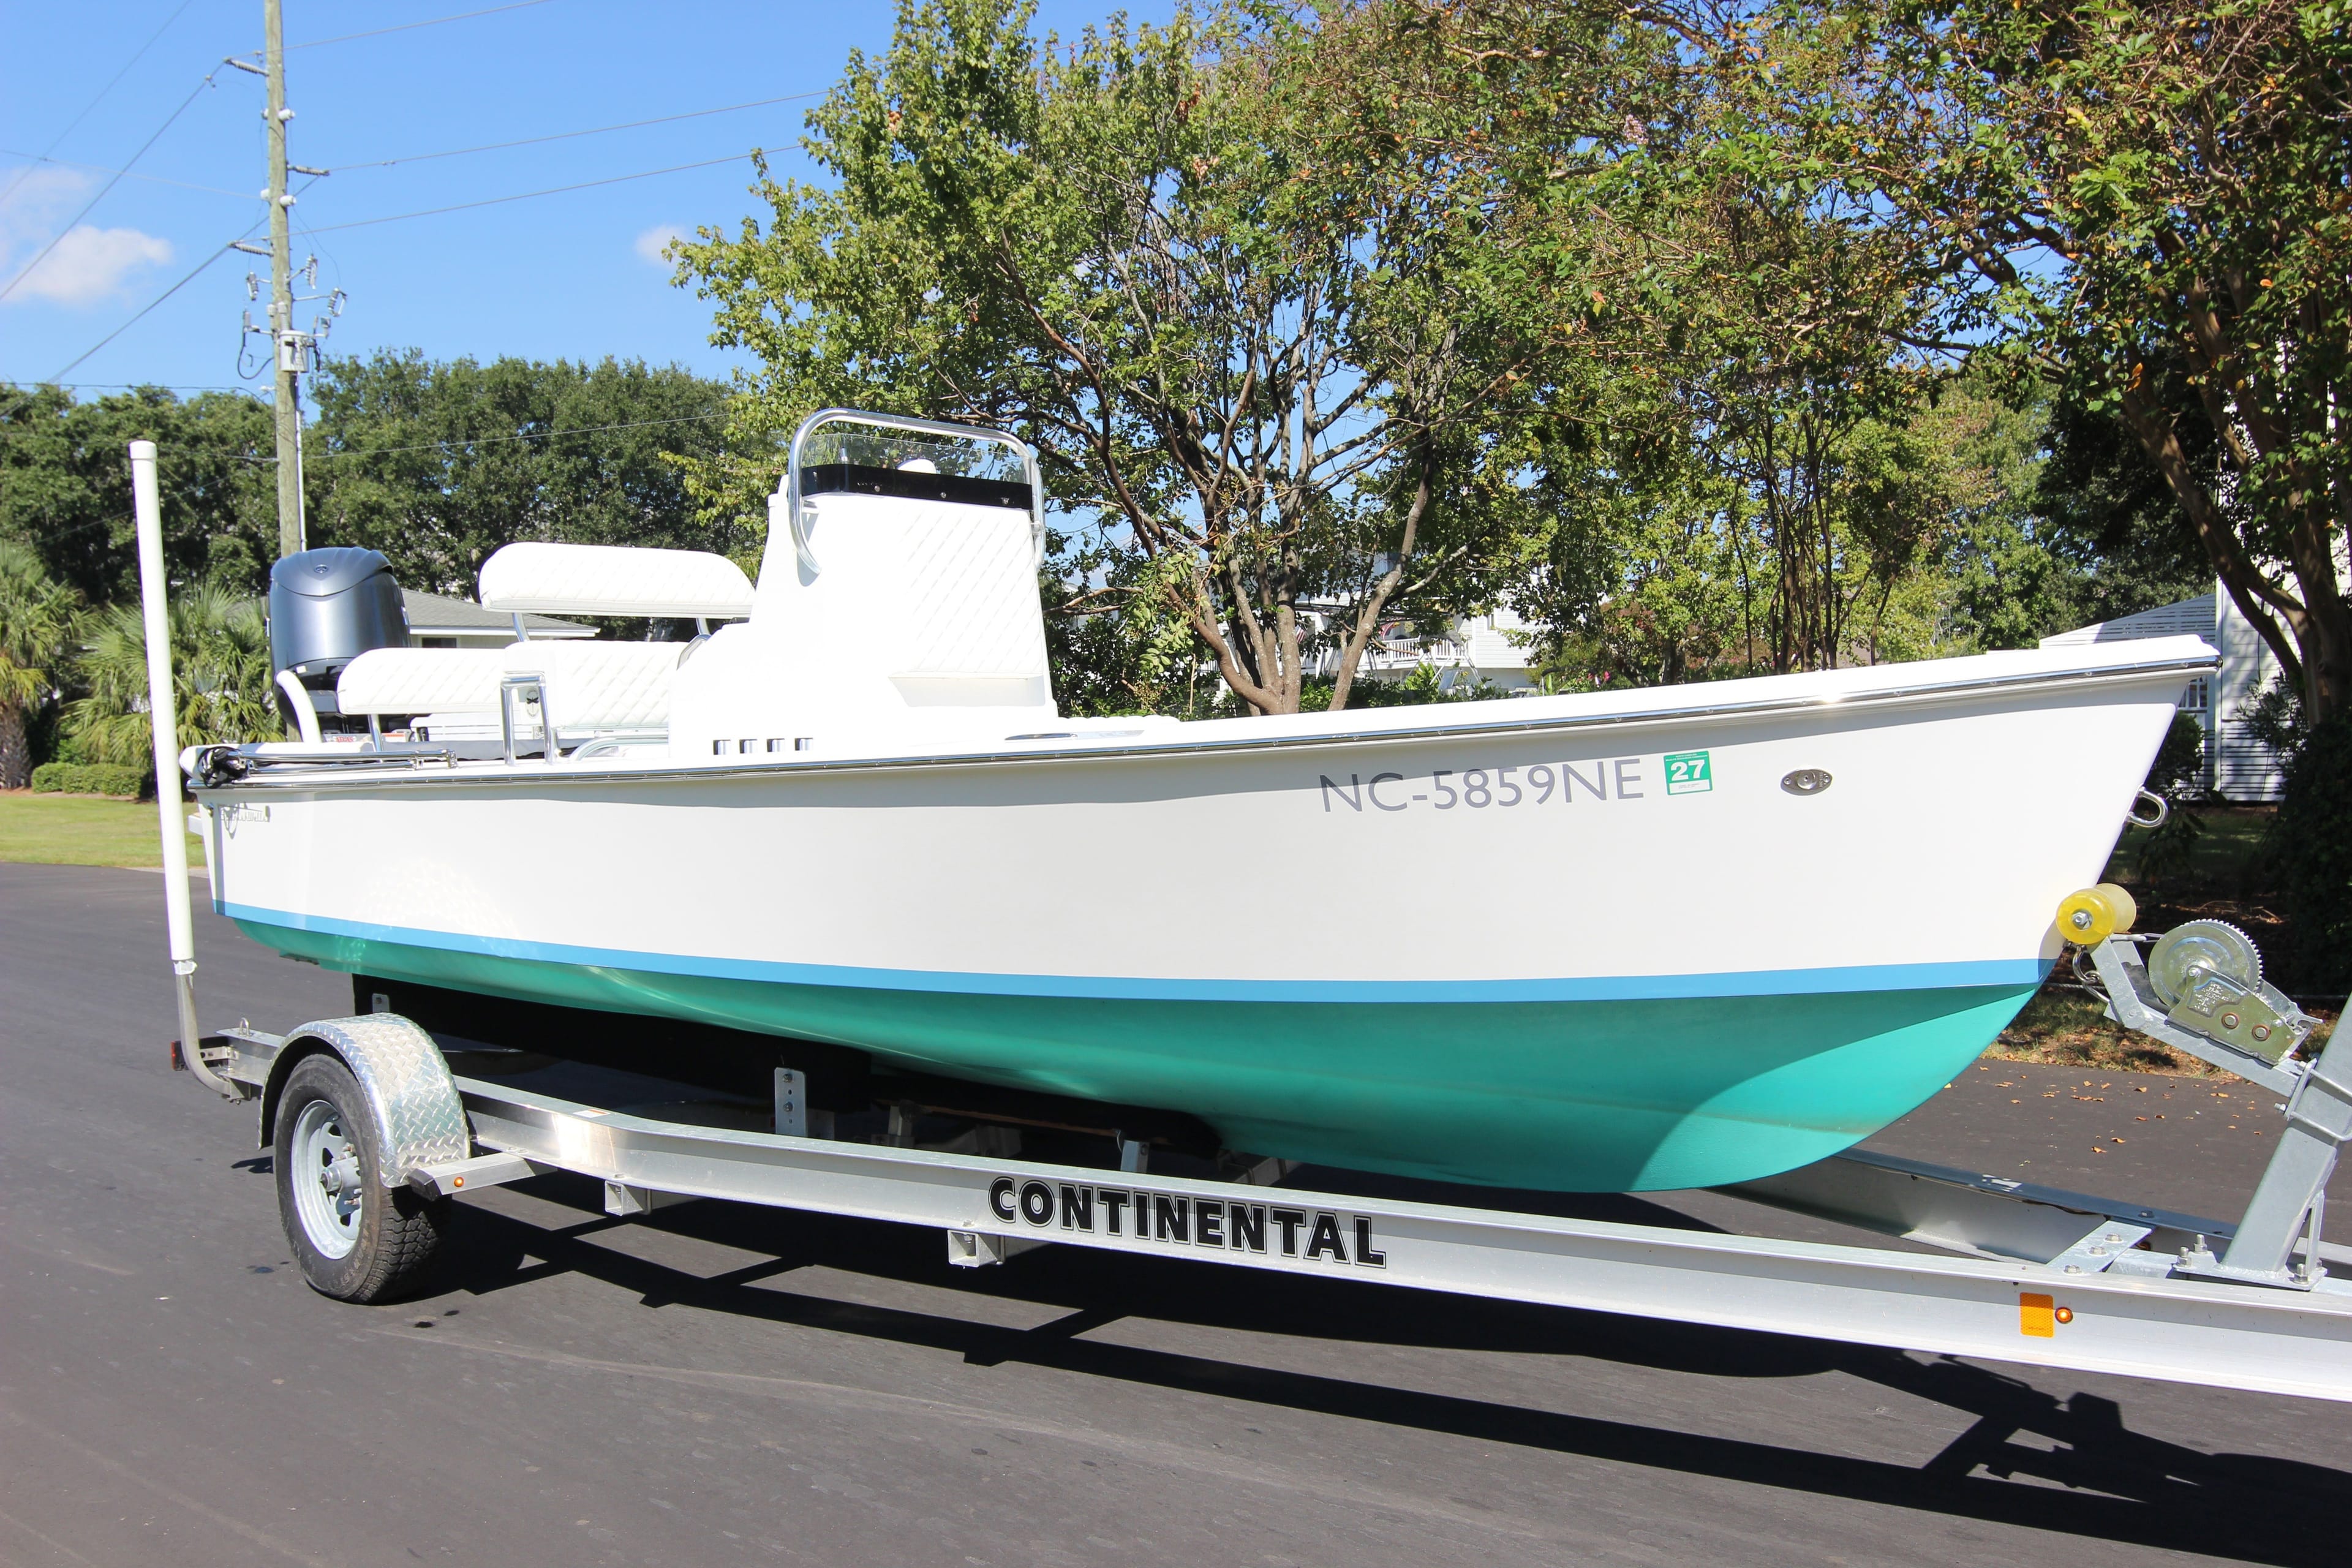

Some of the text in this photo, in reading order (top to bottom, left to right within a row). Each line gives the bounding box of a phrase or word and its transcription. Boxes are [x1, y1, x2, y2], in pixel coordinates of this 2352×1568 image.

[1320, 758, 1644, 813] NC-5859NE
[1670, 759, 1705, 782] 27
[987, 1177, 1387, 1269] CONTINENTAL
